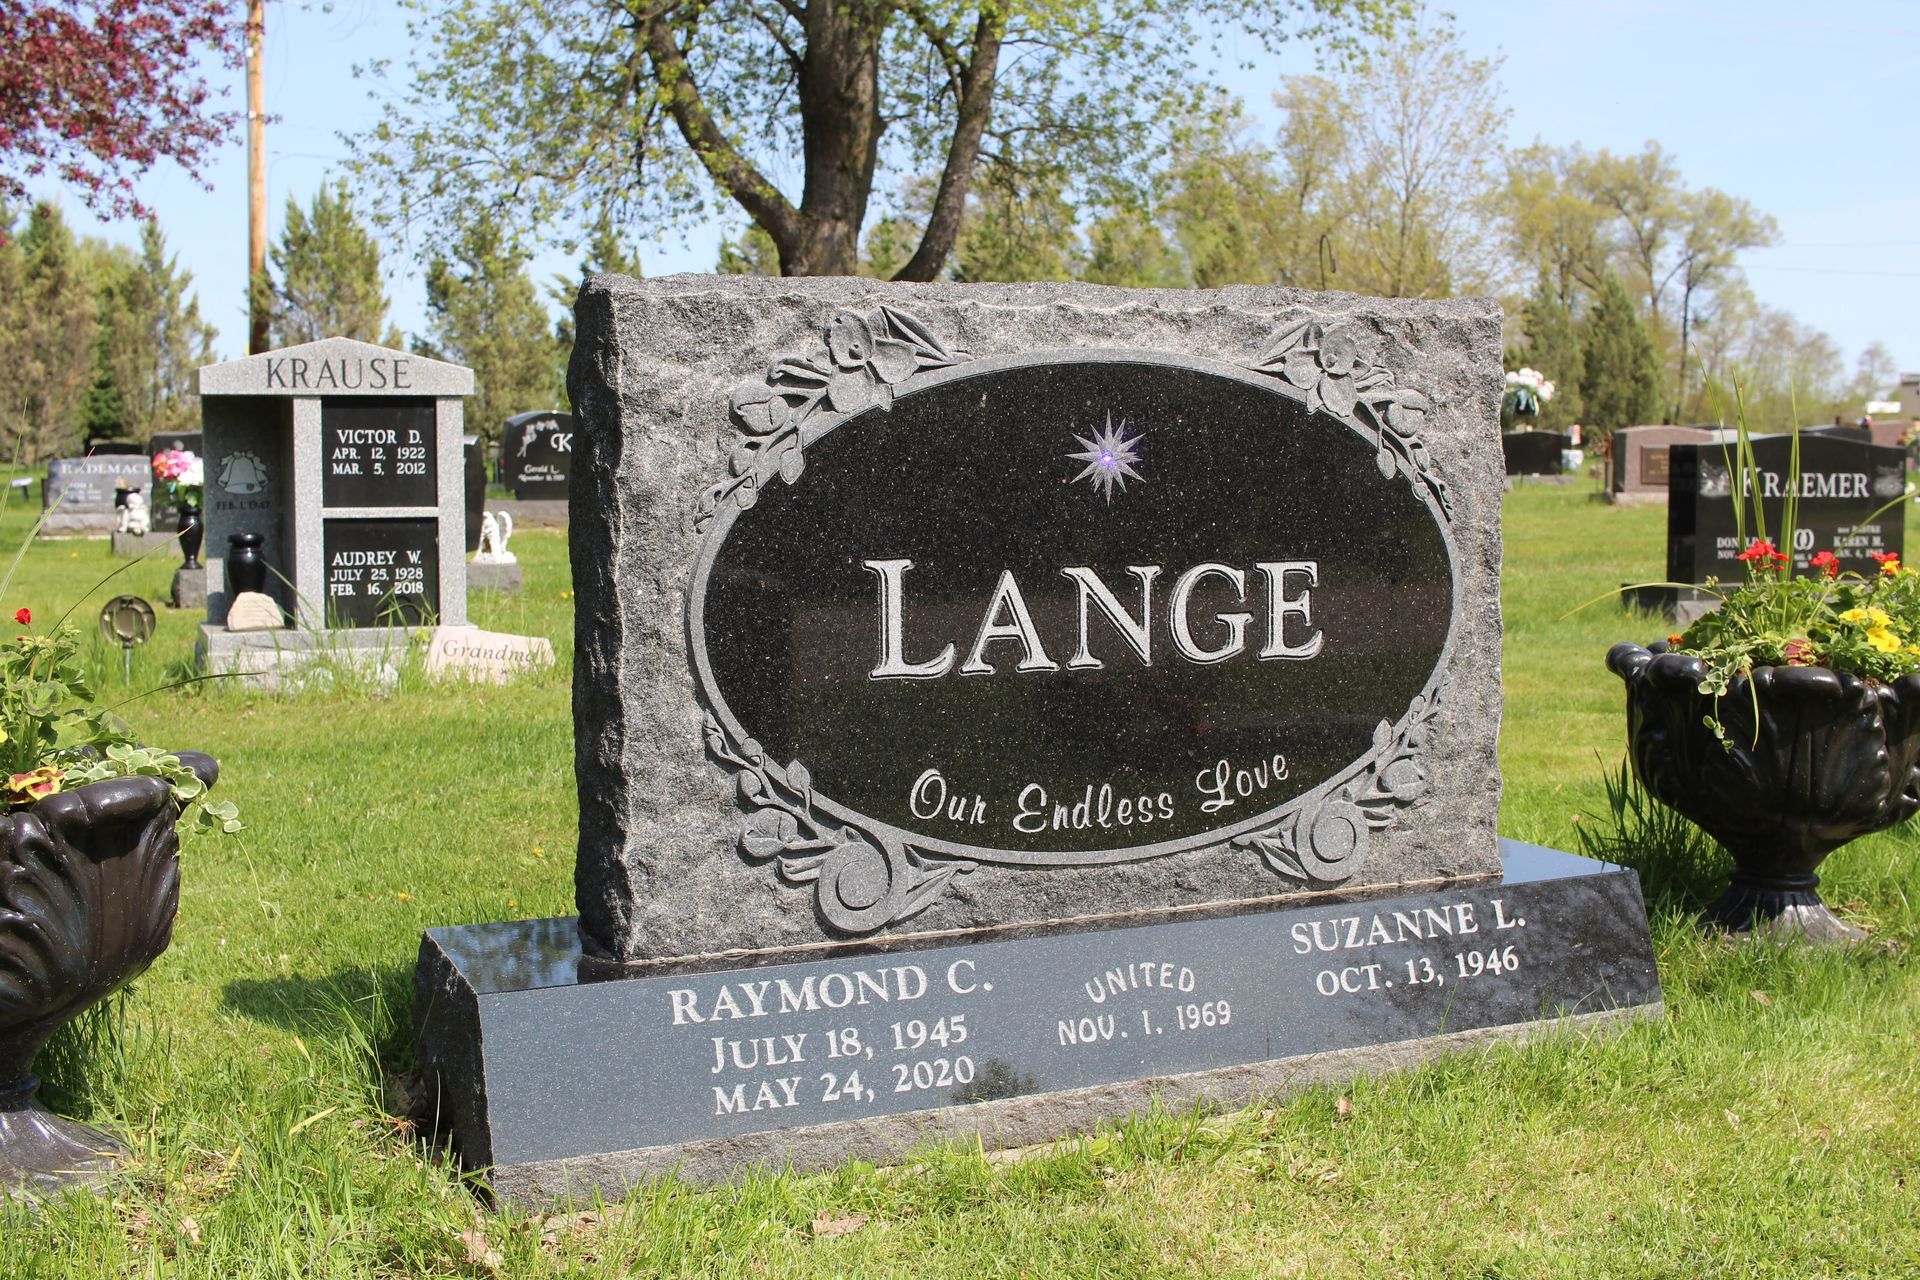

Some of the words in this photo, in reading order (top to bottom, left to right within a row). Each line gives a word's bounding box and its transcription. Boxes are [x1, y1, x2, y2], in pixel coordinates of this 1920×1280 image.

[266, 358, 411, 389] KRAUSE
[332, 447, 361, 460] APR.
[371, 447, 386, 460] 12,
[397, 447, 426, 460] 1922
[337, 429, 397, 444] VICTOR
[409, 429, 423, 444] D.
[332, 463, 363, 475] MAR.
[373, 463, 385, 476] 5,
[397, 462, 426, 475] 2012
[330, 568, 363, 582] JULY
[371, 568, 389, 581] 25,
[395, 567, 423, 580] 1928
[332, 551, 396, 566] AUDREY
[406, 550, 421, 565] W.
[330, 583, 356, 596] FEB.
[394, 581, 424, 594] 2018
[861, 558, 1324, 681] LANGE
[909, 767, 987, 826] Our
[1012, 782, 1175, 834] Endless
[1196, 753, 1290, 813] Love
[1290, 900, 1480, 955] SUZANNE
[1494, 899, 1527, 930] L.
[667, 965, 928, 1025] RAYMOND
[947, 960, 995, 995] C.
[1084, 961, 1197, 1004] UNITED
[1315, 963, 1393, 997] OCT.
[1405, 956, 1445, 988] 13,
[1455, 944, 1520, 979] 1946
[711, 1032, 808, 1075] JULY
[825, 1027, 874, 1061] 18,
[891, 1013, 968, 1051] 1945
[1058, 1013, 1129, 1046] NOV.
[1141, 1009, 1163, 1036] 1,
[1176, 999, 1231, 1031] 1969
[712, 1076, 802, 1116] MAY
[820, 1069, 876, 1104] 24,
[892, 1055, 975, 1093] 2020
